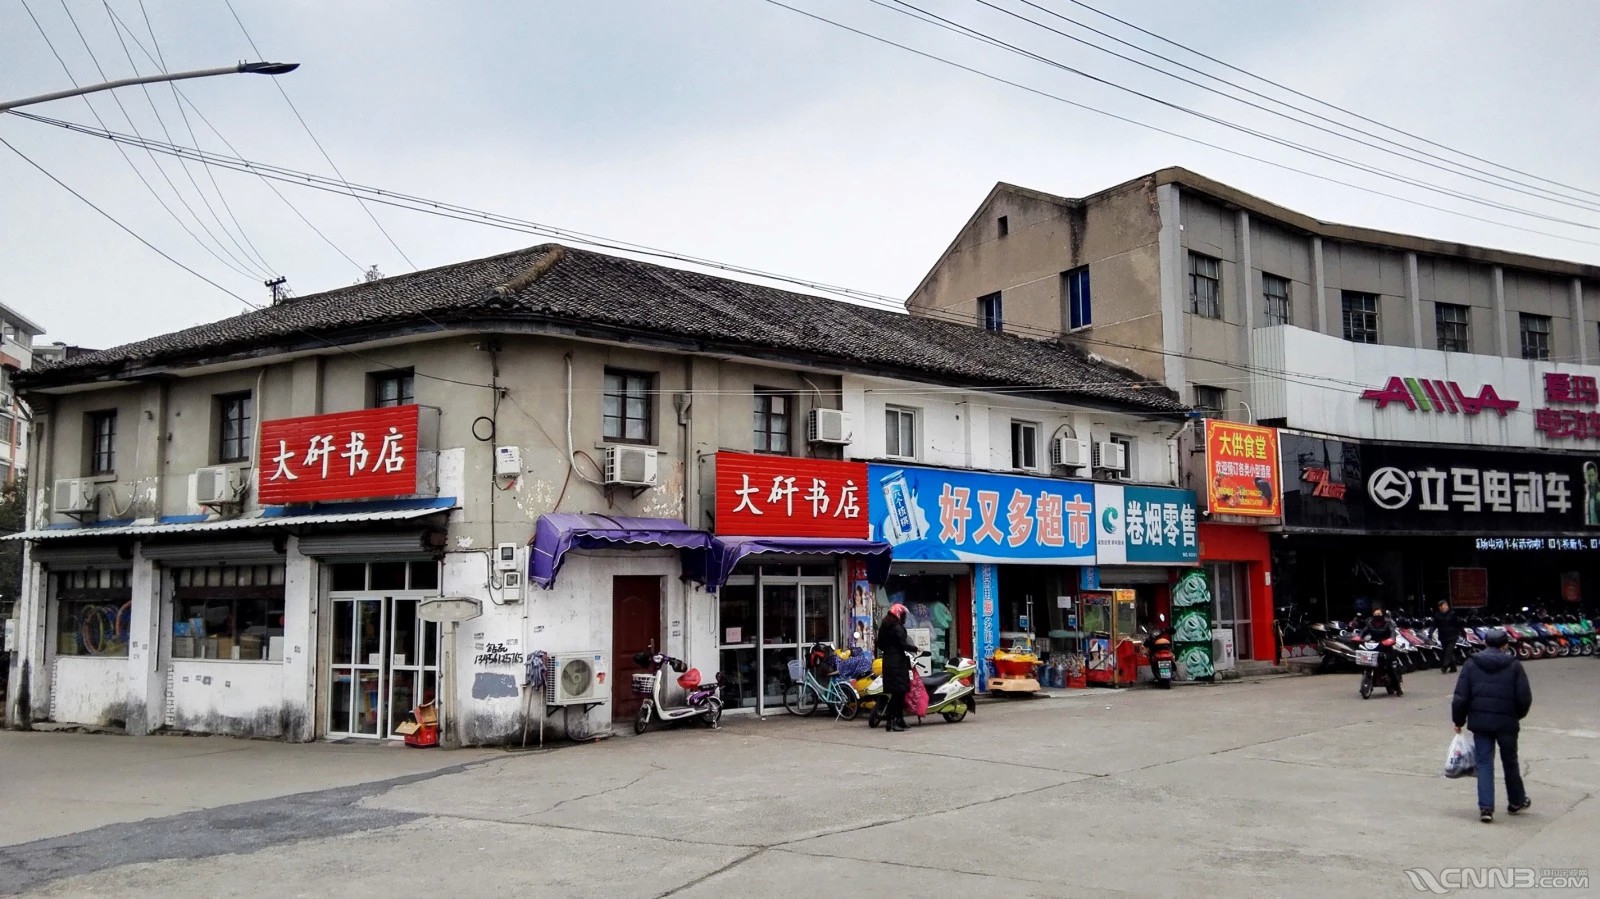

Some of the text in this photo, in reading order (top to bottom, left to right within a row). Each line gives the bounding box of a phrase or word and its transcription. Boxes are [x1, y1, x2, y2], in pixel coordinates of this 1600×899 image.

[1543, 372, 1599, 405] 爱玛
[1219, 430, 1267, 460] 大供食堂
[1416, 467, 1572, 514] 立马电动车
[939, 482, 1092, 549] 好又多超市
[1126, 500, 1197, 547] 卷烟零售
